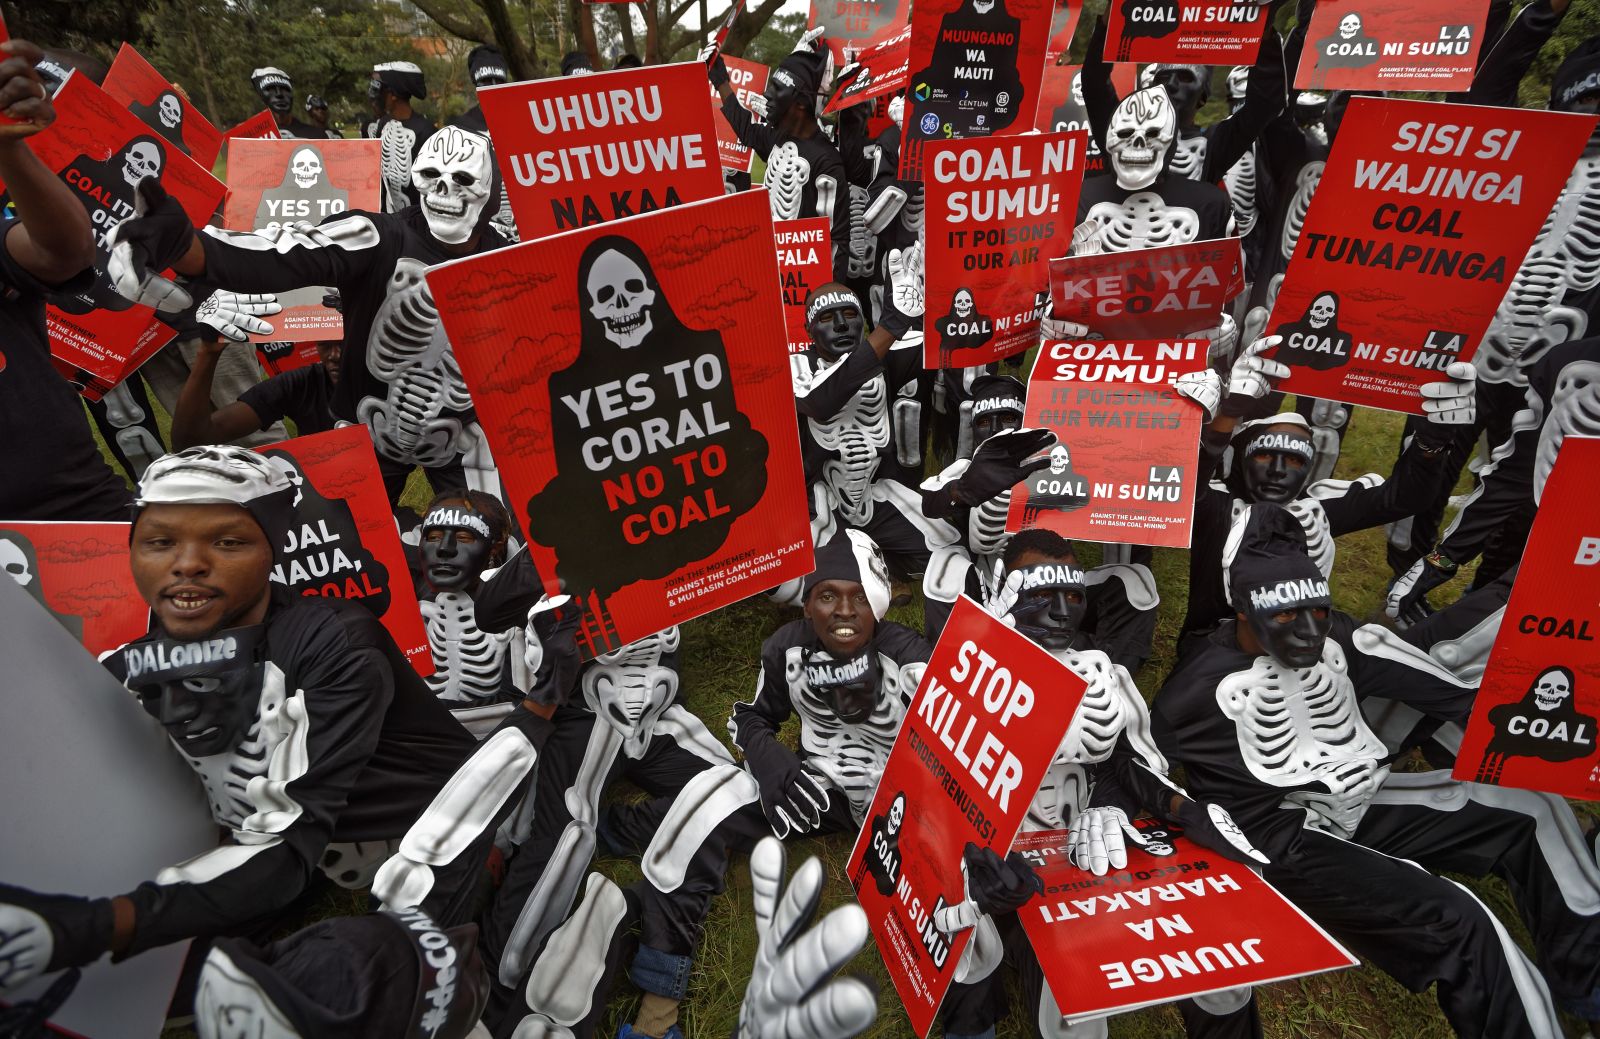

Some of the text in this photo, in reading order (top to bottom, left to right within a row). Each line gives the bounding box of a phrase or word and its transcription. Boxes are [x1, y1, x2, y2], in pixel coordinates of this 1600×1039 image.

[837, 2, 884, 16] DIRTY
[1131, 6, 1260, 23] COAL NI SUMU
[845, 17, 871, 32] LIE
[942, 30, 1014, 45] MUUNGANO
[1440, 26, 1470, 40] LA
[966, 49, 986, 62] WA
[1326, 42, 1469, 56] COAL NI SUMU
[845, 79, 871, 93] COAL
[873, 74, 885, 82] NI
[954, 66, 993, 80] MAUTI
[528, 85, 664, 135] UHURU
[959, 100, 988, 108] CENTUM
[725, 140, 748, 153] SUMU
[1392, 121, 1522, 161] SISI SI
[510, 133, 707, 187] USITUUWE
[934, 145, 1031, 183] COAL
[1042, 138, 1076, 175] NI
[65, 168, 137, 218] COALIT
[1354, 159, 1523, 205] WAJINGA
[266, 199, 345, 217] YES TO
[550, 192, 606, 230] NA
[946, 184, 1059, 223] SUMU:
[91, 209, 120, 229] OF
[1372, 203, 1465, 240] COAL
[948, 221, 1055, 248] IT POISONS
[963, 247, 1039, 271] OUR AIR
[1305, 233, 1507, 284] TUNAPINGA
[1063, 266, 1220, 300] KENYA
[1096, 291, 1212, 317] COAL
[60, 317, 97, 340] MOVEMENT
[947, 321, 990, 336] COAL
[996, 317, 1010, 331] NI
[1013, 307, 1043, 326] SUM
[55, 323, 69, 335] THE
[69, 330, 88, 344] LAMU
[88, 341, 105, 353] COAL
[106, 349, 126, 363] PLANT
[63, 336, 105, 361] COAL MINING
[1050, 342, 1197, 360] COAL NI
[1288, 332, 1455, 372] COAL NI SUMU
[1424, 331, 1461, 352] LA
[1052, 364, 1178, 384] SUMU:
[1344, 374, 1408, 389] AGAINST THE LAMU
[560, 353, 723, 431] YES TO
[1051, 388, 1174, 406] IT POISONS
[1362, 383, 1383, 392] BASIN
[1383, 386, 1400, 395] COAL
[1039, 410, 1181, 430] OUR WATERS
[581, 401, 731, 473] CORAL
[601, 443, 728, 513] NO TO
[1150, 467, 1181, 483] LA
[1036, 480, 1181, 502] COAL NI SUMU
[620, 489, 732, 546] COAL
[664, 550, 757, 589] JOIN THE MOVEMENT
[666, 540, 805, 599] AGAINST THE LAMU COAL PLANT
[678, 593, 695, 605] MUI
[697, 581, 725, 597] BASIN
[726, 573, 749, 585] COAL
[750, 559, 782, 576] MINING
[1518, 614, 1595, 641] COAL
[406, 645, 427, 656] PLANT
[950, 640, 1036, 728] STOP
[917, 675, 1024, 814] KILLER
[1507, 715, 1591, 745] COAL
[907, 726, 998, 846] TENDERPRENUERS!
[1047, 860, 1210, 894] #deCOALonize
[874, 830, 898, 884] COAL
[897, 874, 912, 906] NI
[908, 897, 948, 968] SUMU
[1038, 873, 1242, 924] HARAKATI
[1125, 914, 1194, 941] NA
[887, 912, 901, 936] AGAINST
[905, 945, 916, 966] LAMU
[913, 963, 923, 982] COAL
[922, 981, 936, 1008] PLANT
[891, 935, 901, 955] BASIN
[900, 952, 909, 971] COAL
[907, 970, 921, 998] MINING
[1100, 938, 1265, 990] JIUNGE
